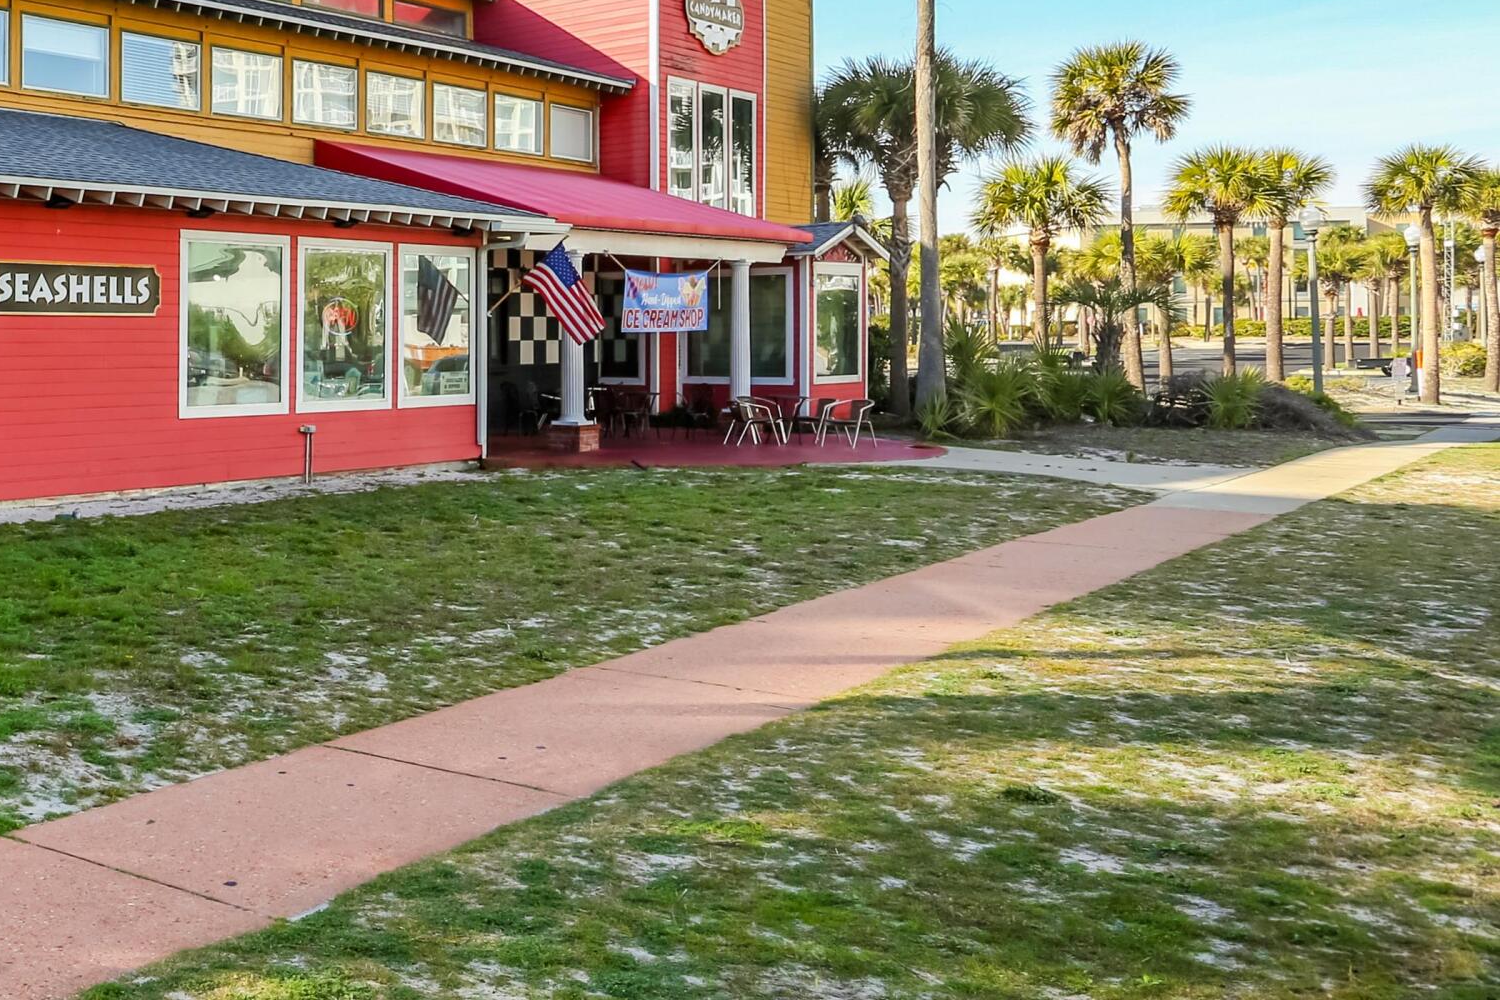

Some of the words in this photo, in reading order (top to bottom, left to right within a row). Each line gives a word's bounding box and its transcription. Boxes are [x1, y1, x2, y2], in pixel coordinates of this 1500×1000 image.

[689, 1, 741, 27] CANDYMAKER
[622, 309, 640, 329] ICE
[642, 309, 679, 329] CREAM
[679, 308, 704, 328] SHOP
